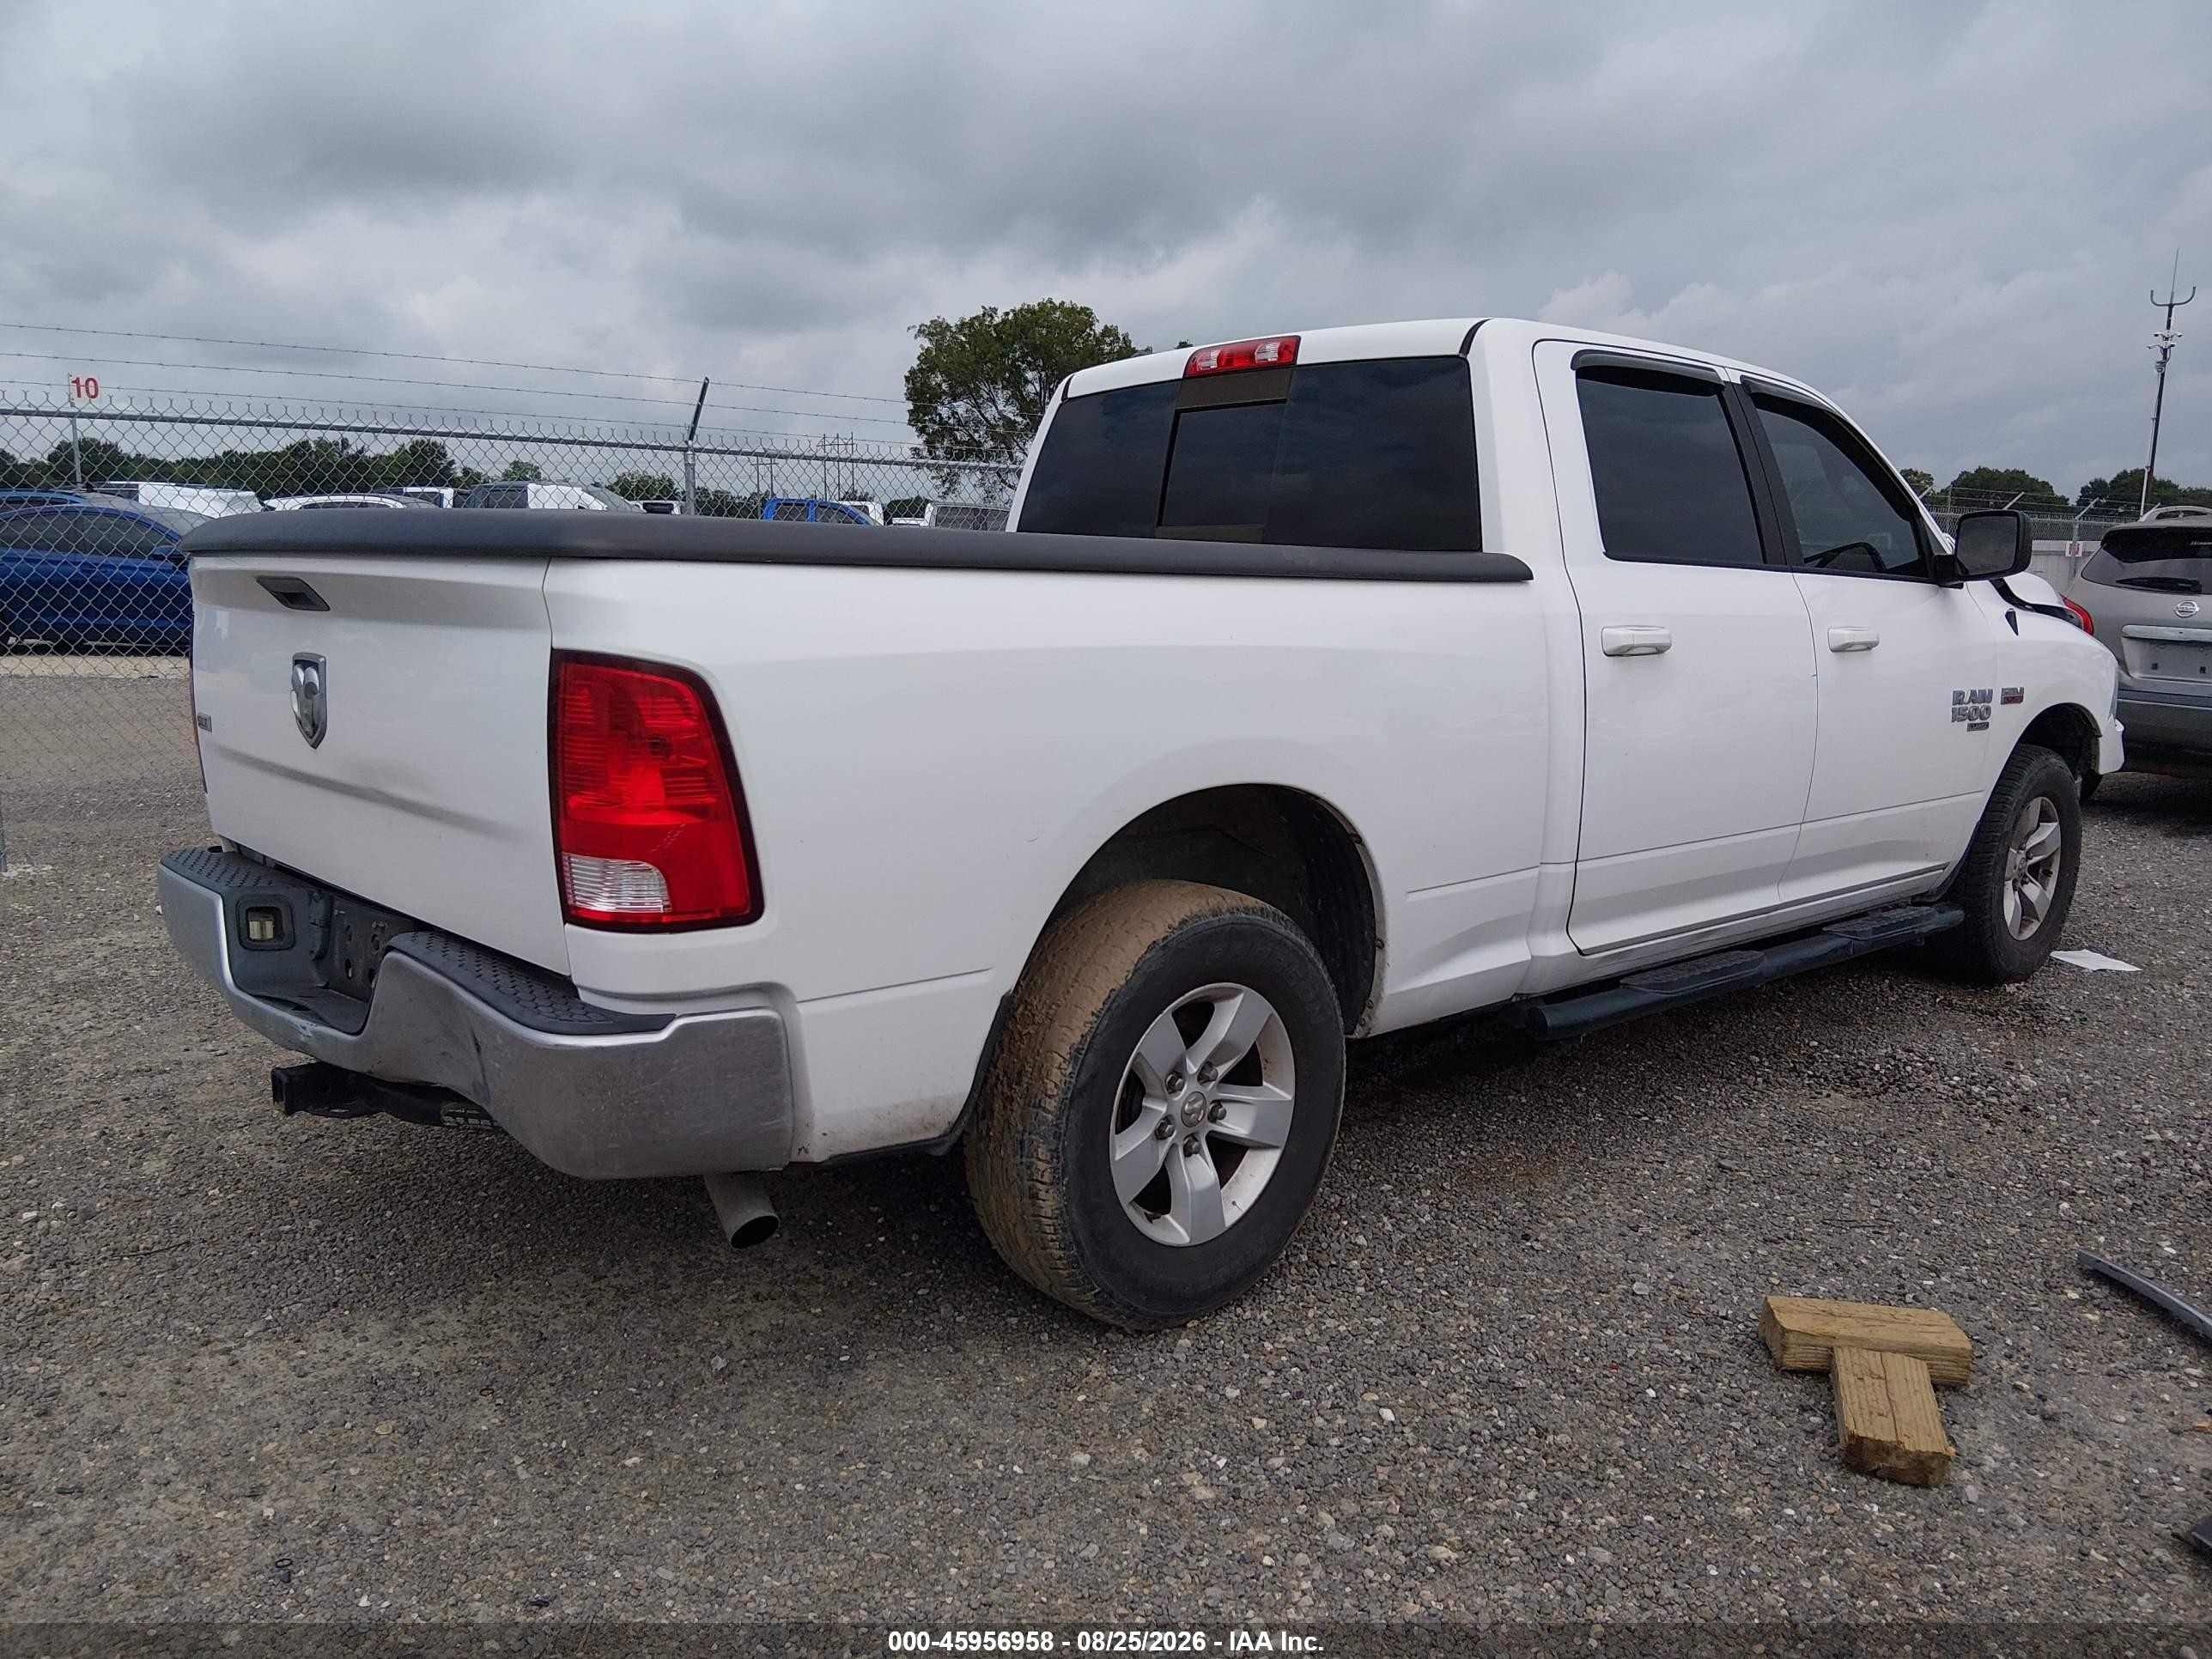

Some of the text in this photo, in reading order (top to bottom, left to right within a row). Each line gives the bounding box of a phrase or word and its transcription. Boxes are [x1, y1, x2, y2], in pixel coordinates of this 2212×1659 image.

[71, 377, 99, 398] 10
[1952, 689, 1993, 705] RAM
[1951, 705, 1991, 722] 1500
